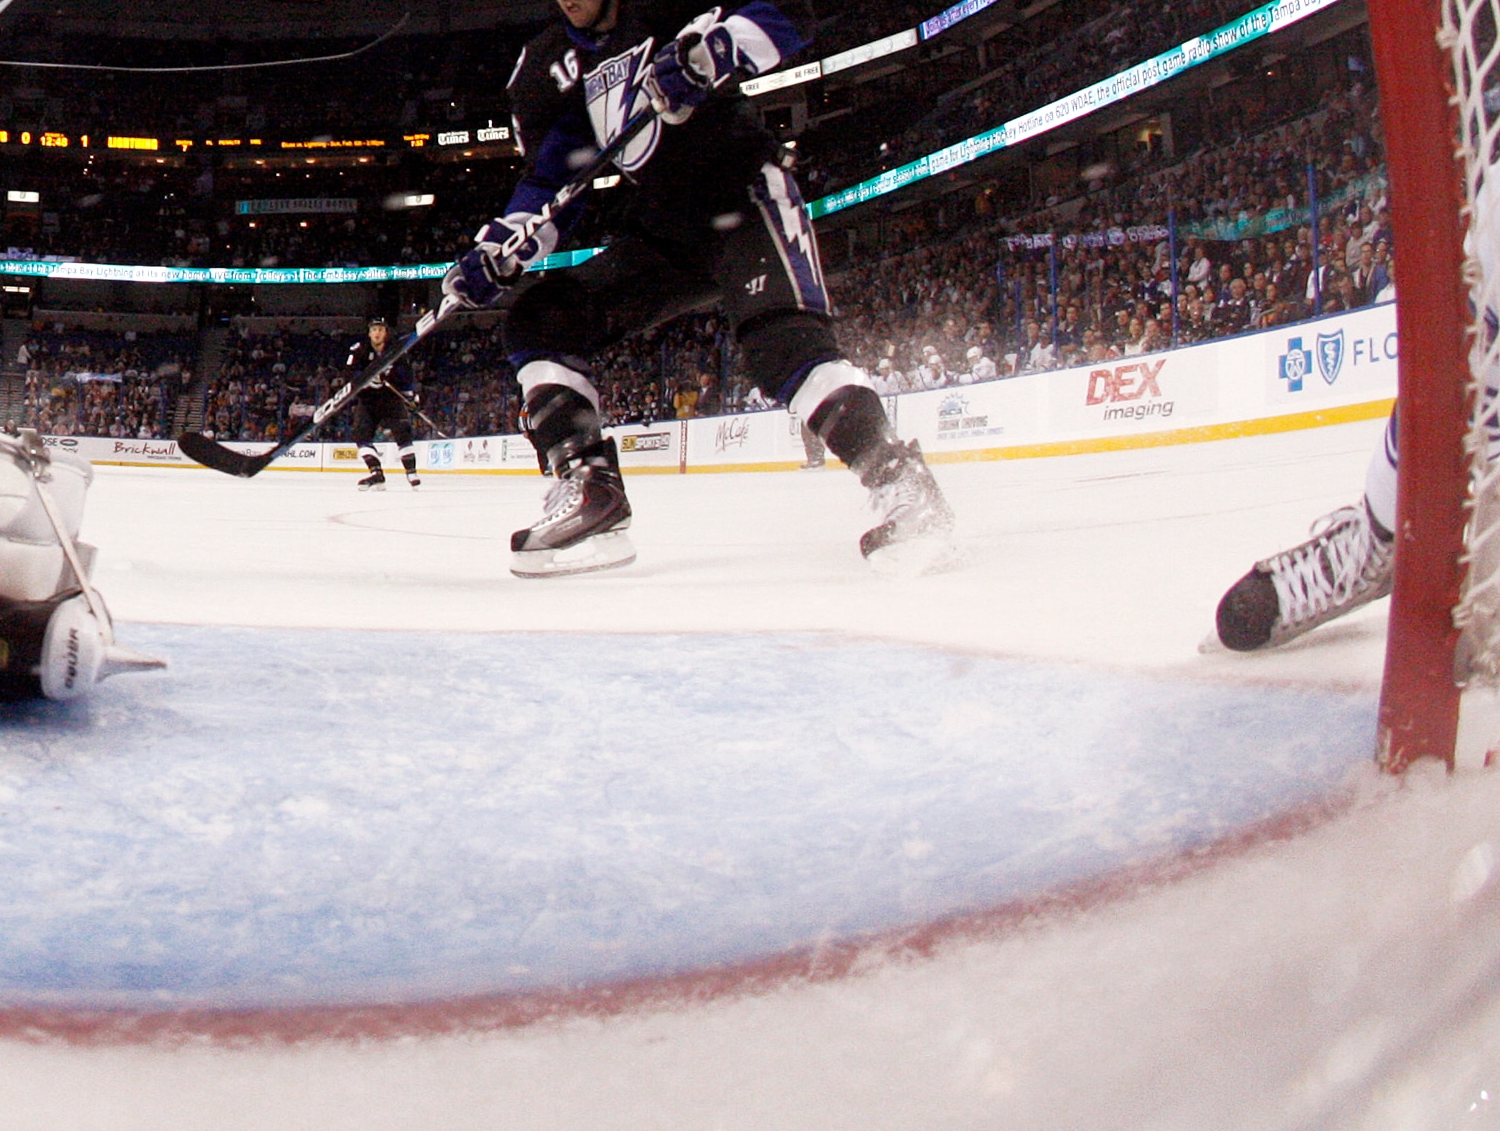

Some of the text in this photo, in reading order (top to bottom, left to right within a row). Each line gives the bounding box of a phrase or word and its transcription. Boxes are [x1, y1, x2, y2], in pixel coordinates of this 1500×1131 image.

[549, 48, 579, 94] 16
[601, 55, 632, 89] BAY
[745, 65, 819, 92] FREE FREE
[930, 155, 949, 172] game
[949, 149, 960, 163] for
[960, 135, 992, 159] Lightning
[1018, 114, 1043, 134] Hotline
[1044, 111, 1054, 124] on
[1055, 100, 1070, 120] 620
[1070, 89, 1096, 112] WDAE,
[1096, 84, 1110, 101] the
[1111, 69, 1140, 96] official
[1142, 60, 1161, 86] post
[1162, 51, 1186, 76] game
[1187, 39, 1211, 62] radio
[1212, 28, 1237, 51] show
[1239, 20, 1250, 38] of
[1250, 12, 1267, 32] the
[1268, 2, 1301, 24] Tampa
[21, 131, 31, 145] 0
[81, 134, 89, 149] 1
[107, 136, 159, 151] LIGHTNING
[438, 127, 510, 146] Times Times
[51, 264, 77, 276] Tampa
[79, 266, 94, 277] Bay
[96, 267, 134, 279] Lightning
[135, 269, 145, 278] at
[147, 269, 158, 279] its
[160, 269, 180, 279] new
[231, 270, 250, 281] from
[304, 270, 319, 281] The
[321, 270, 360, 283] Embassy
[1085, 358, 1167, 407] DEX
[1103, 399, 1175, 422] imaging
[113, 440, 177, 456] Brickwall
[621, 435, 662, 451] SUN SPORTS
[715, 417, 750, 452] McCafé
[64, 626, 80, 689] BAUER
